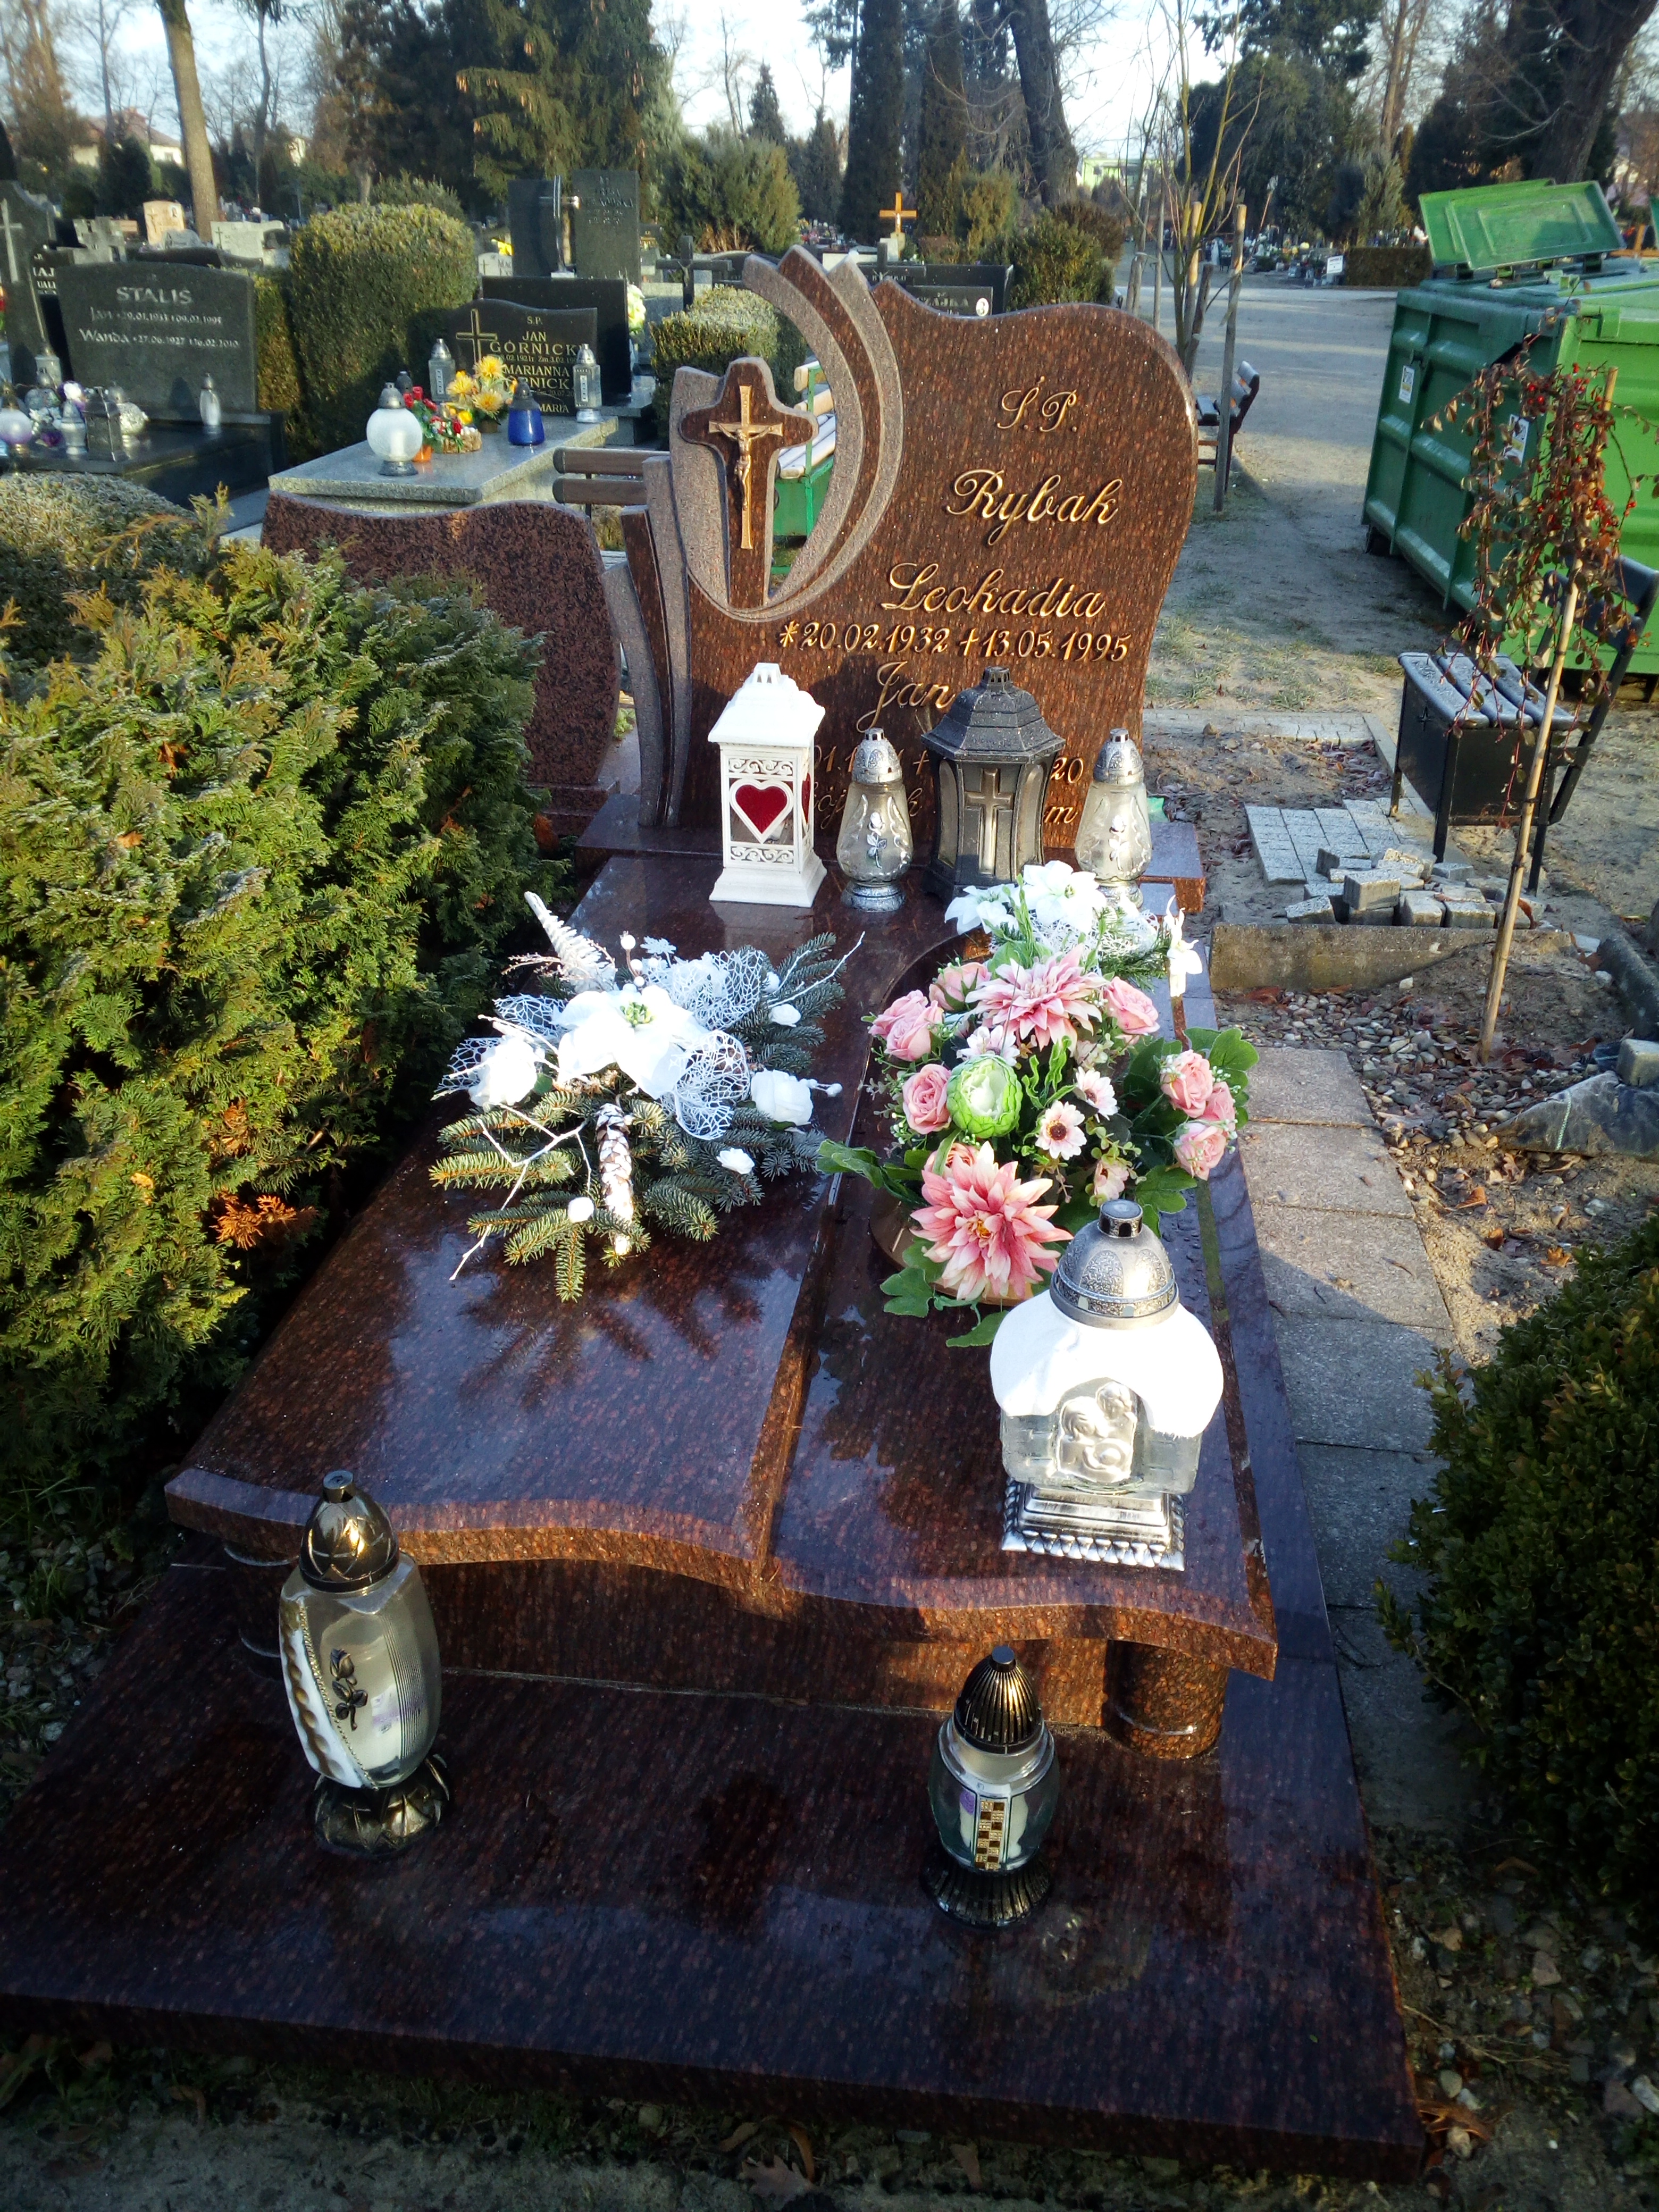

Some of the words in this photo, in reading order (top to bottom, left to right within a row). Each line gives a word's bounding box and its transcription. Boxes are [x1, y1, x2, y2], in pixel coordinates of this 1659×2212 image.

[522, 331, 546, 342] JAN
[505, 364, 570, 377] MARIANNA
[539, 404, 570, 413] MARIA
[946, 469, 1122, 546] Rybak
[881, 563, 1106, 618] Leokadia
[856, 660, 956, 733] Jan
